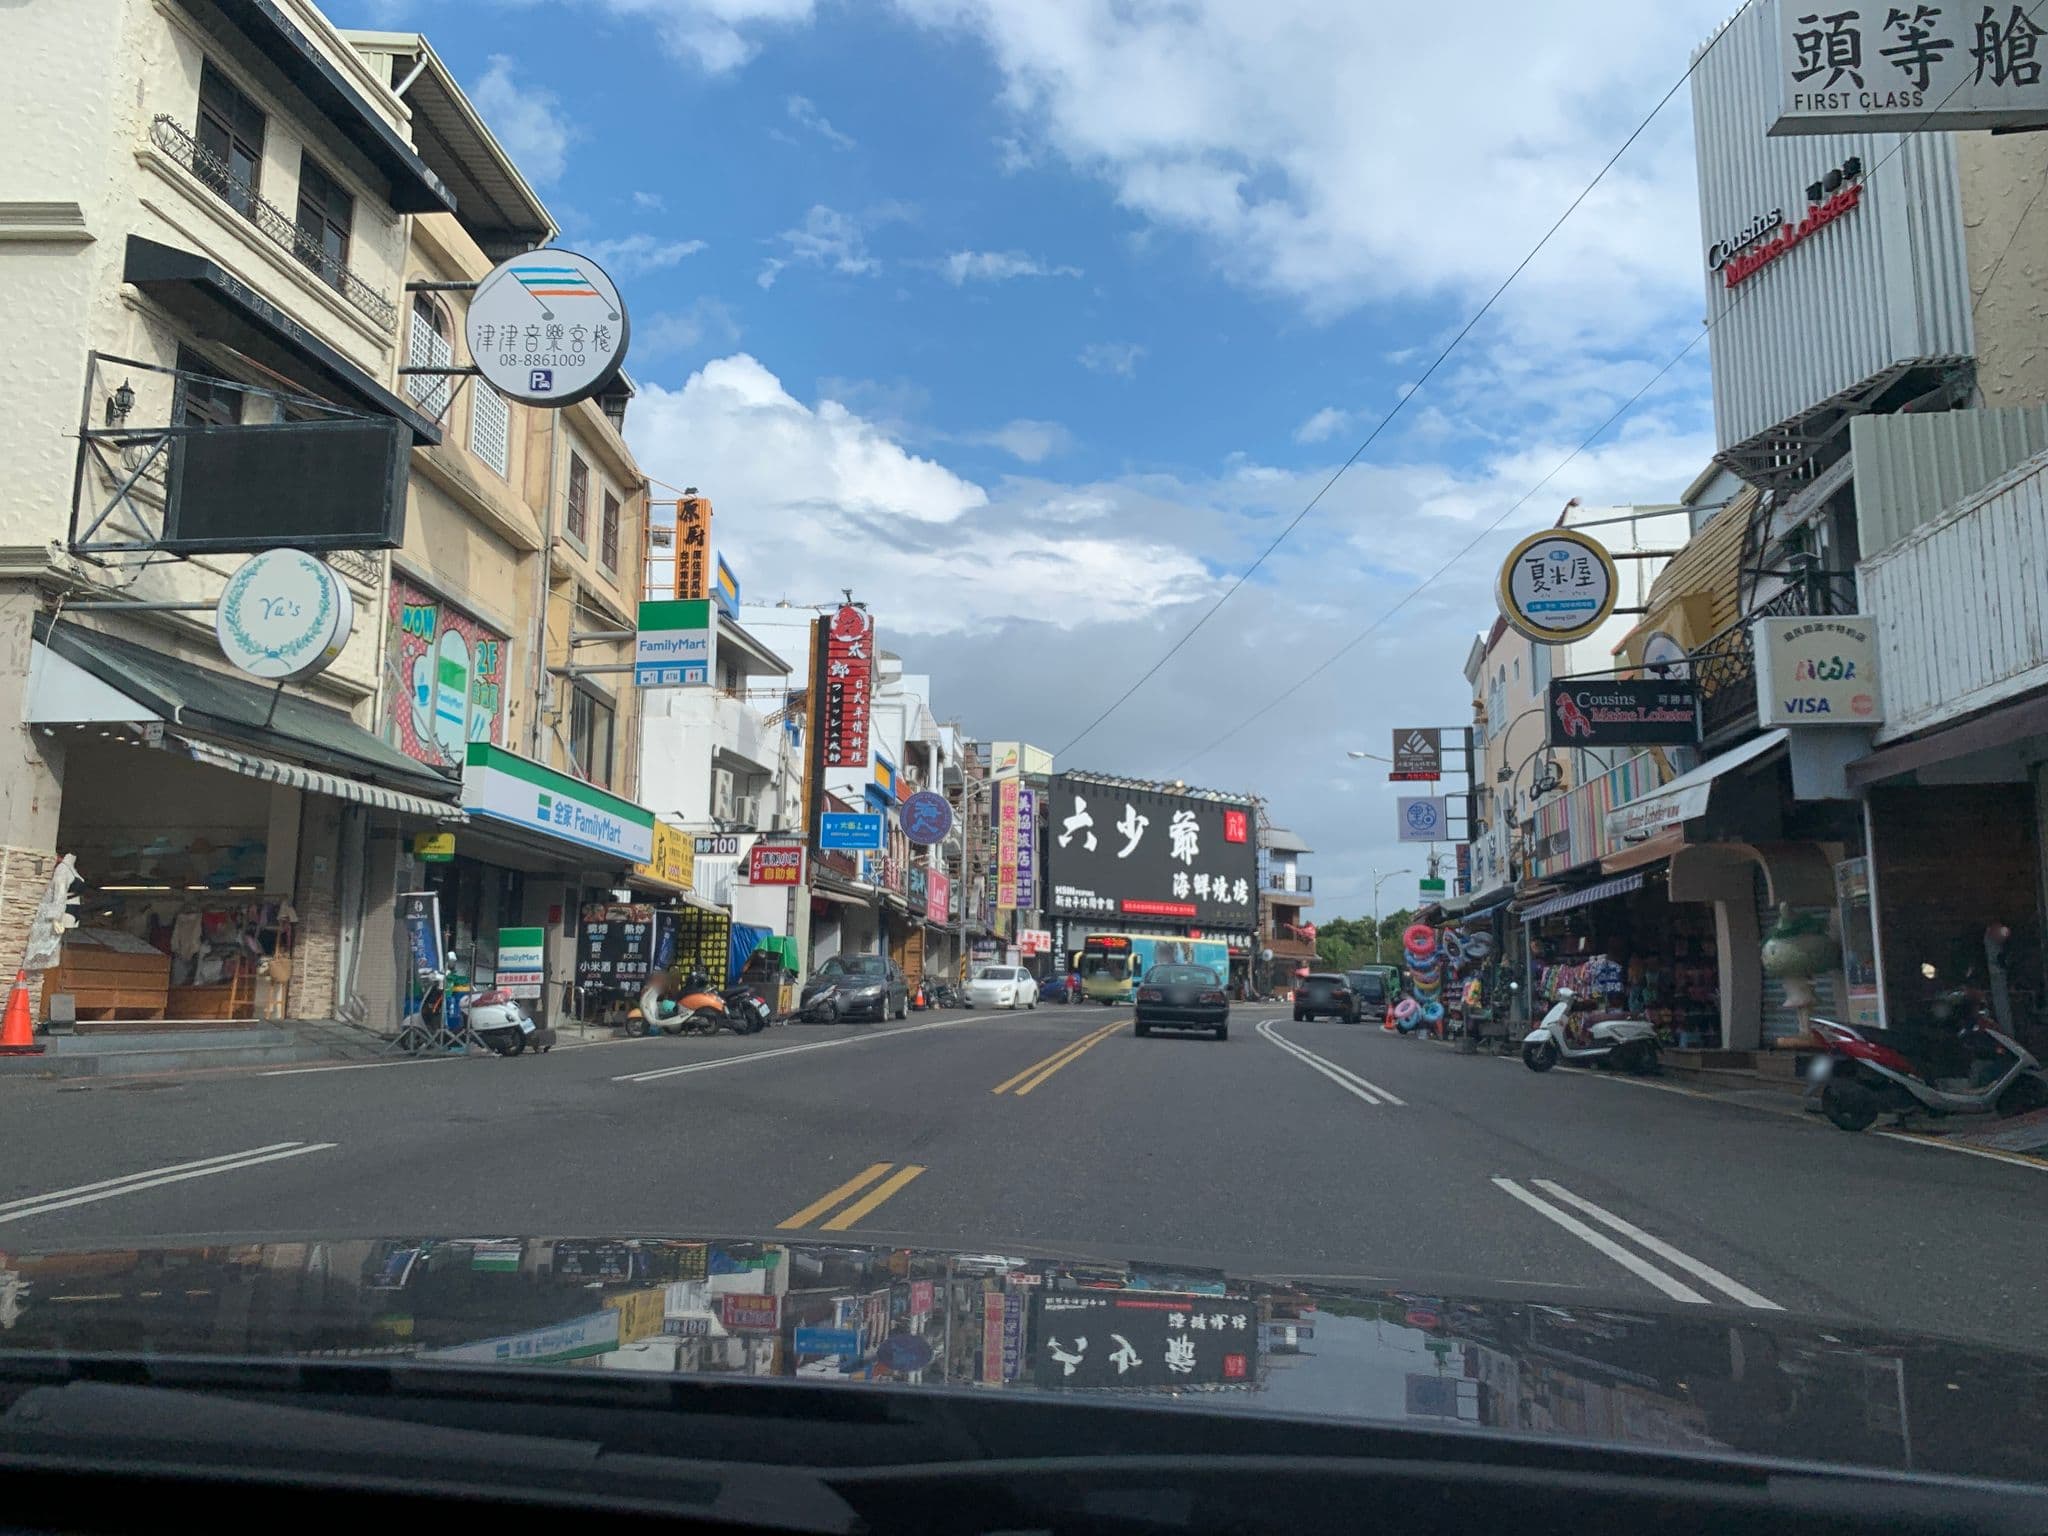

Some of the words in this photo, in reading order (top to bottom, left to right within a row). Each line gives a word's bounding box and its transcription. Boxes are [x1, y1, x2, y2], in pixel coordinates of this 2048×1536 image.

[1792, 5, 2048, 91] 頭等艙
[1795, 93, 1850, 110] FIRST
[1859, 91, 1924, 109] CLASS
[1709, 208, 1783, 272] Cousins
[476, 324, 611, 353] 津津音樂客棧
[500, 354, 586, 366] 08-8861009
[1525, 557, 1595, 593] 夏米屋
[477, 640, 498, 675] 2F
[640, 639, 706, 653] FamilyMart
[1576, 691, 1636, 708] Cousins
[1785, 698, 1831, 713] VISA
[1591, 707, 1638, 722] Maine
[1638, 706, 1694, 722] Lobster
[555, 800, 573, 828] 全家
[574, 807, 622, 844] FamilyMart
[1058, 795, 1200, 865] 六少爺
[500, 953, 540, 964] FamilyMart
